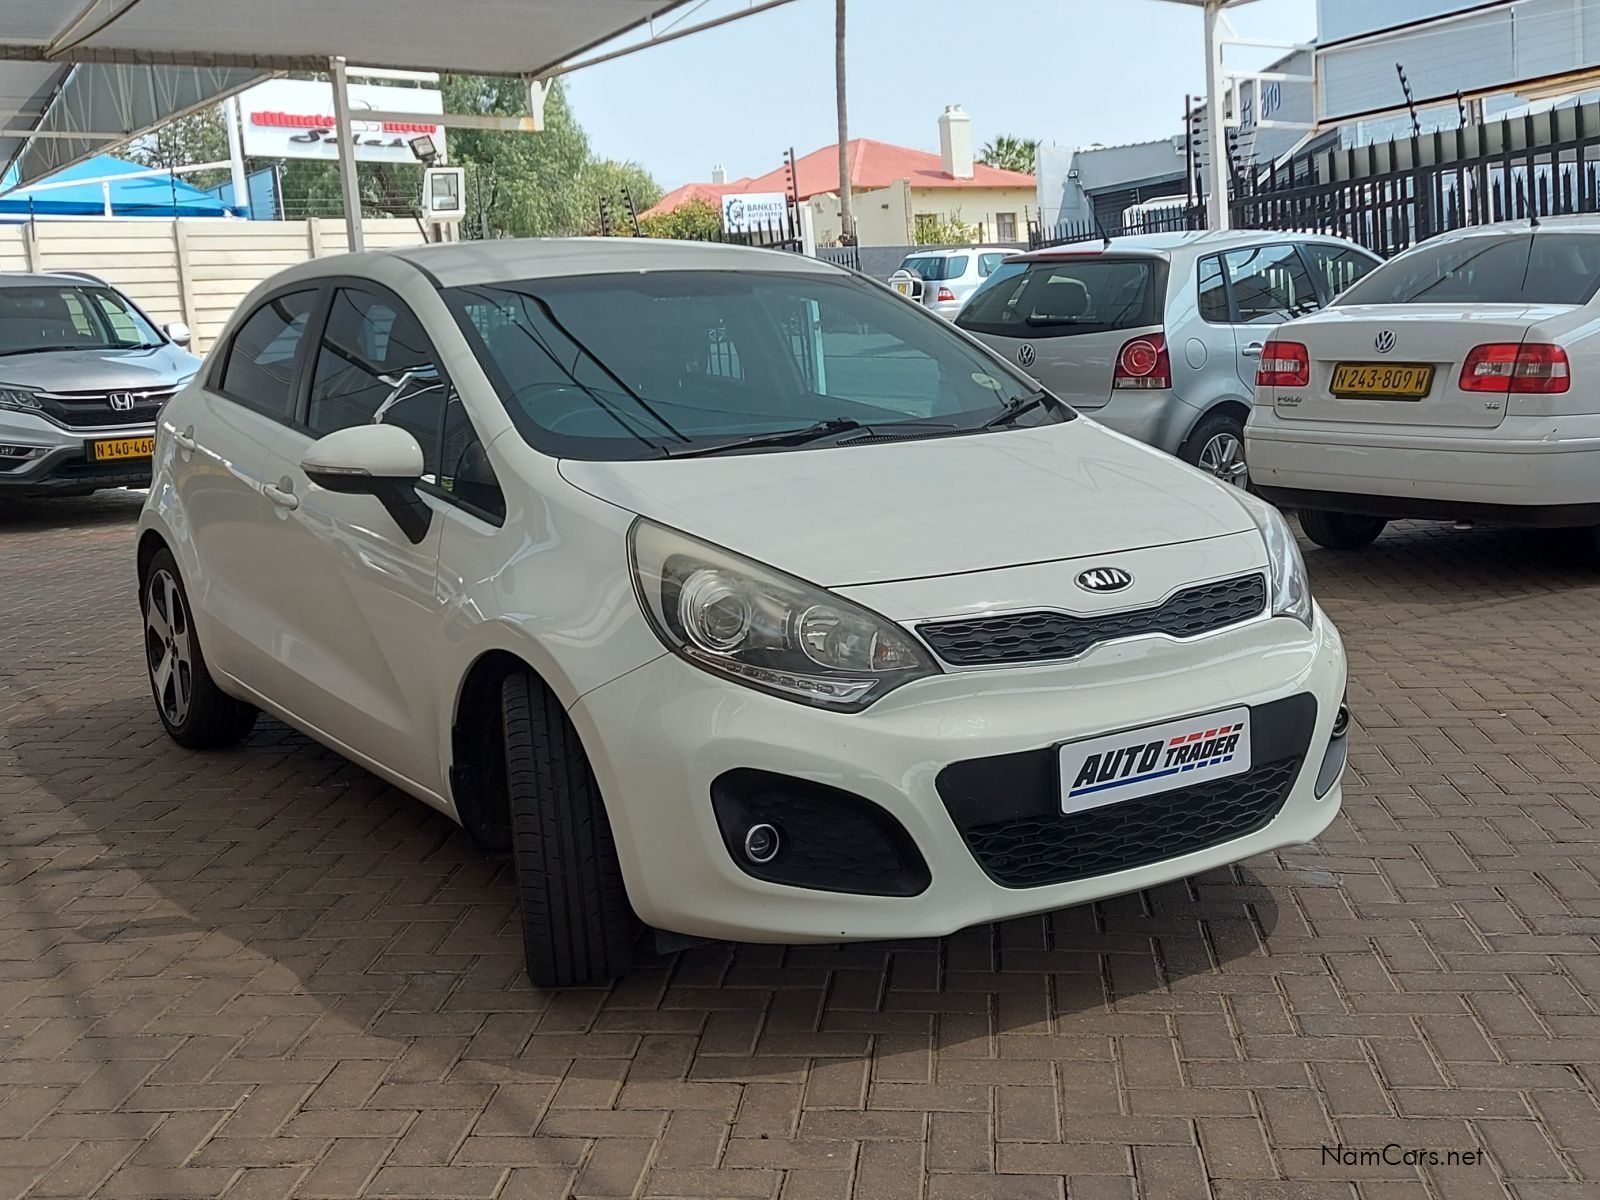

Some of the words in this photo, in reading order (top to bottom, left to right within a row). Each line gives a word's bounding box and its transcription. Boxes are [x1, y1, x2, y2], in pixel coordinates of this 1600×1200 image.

[747, 203, 783, 212] BANKETS
[1336, 368, 1348, 388] N
[1348, 369, 1413, 389] 243-809
[1414, 369, 1428, 390] W
[96, 443, 105, 458] N
[1082, 568, 1129, 588] KIA
[1072, 740, 1165, 789] AUTO
[1164, 733, 1241, 768] TRADER
